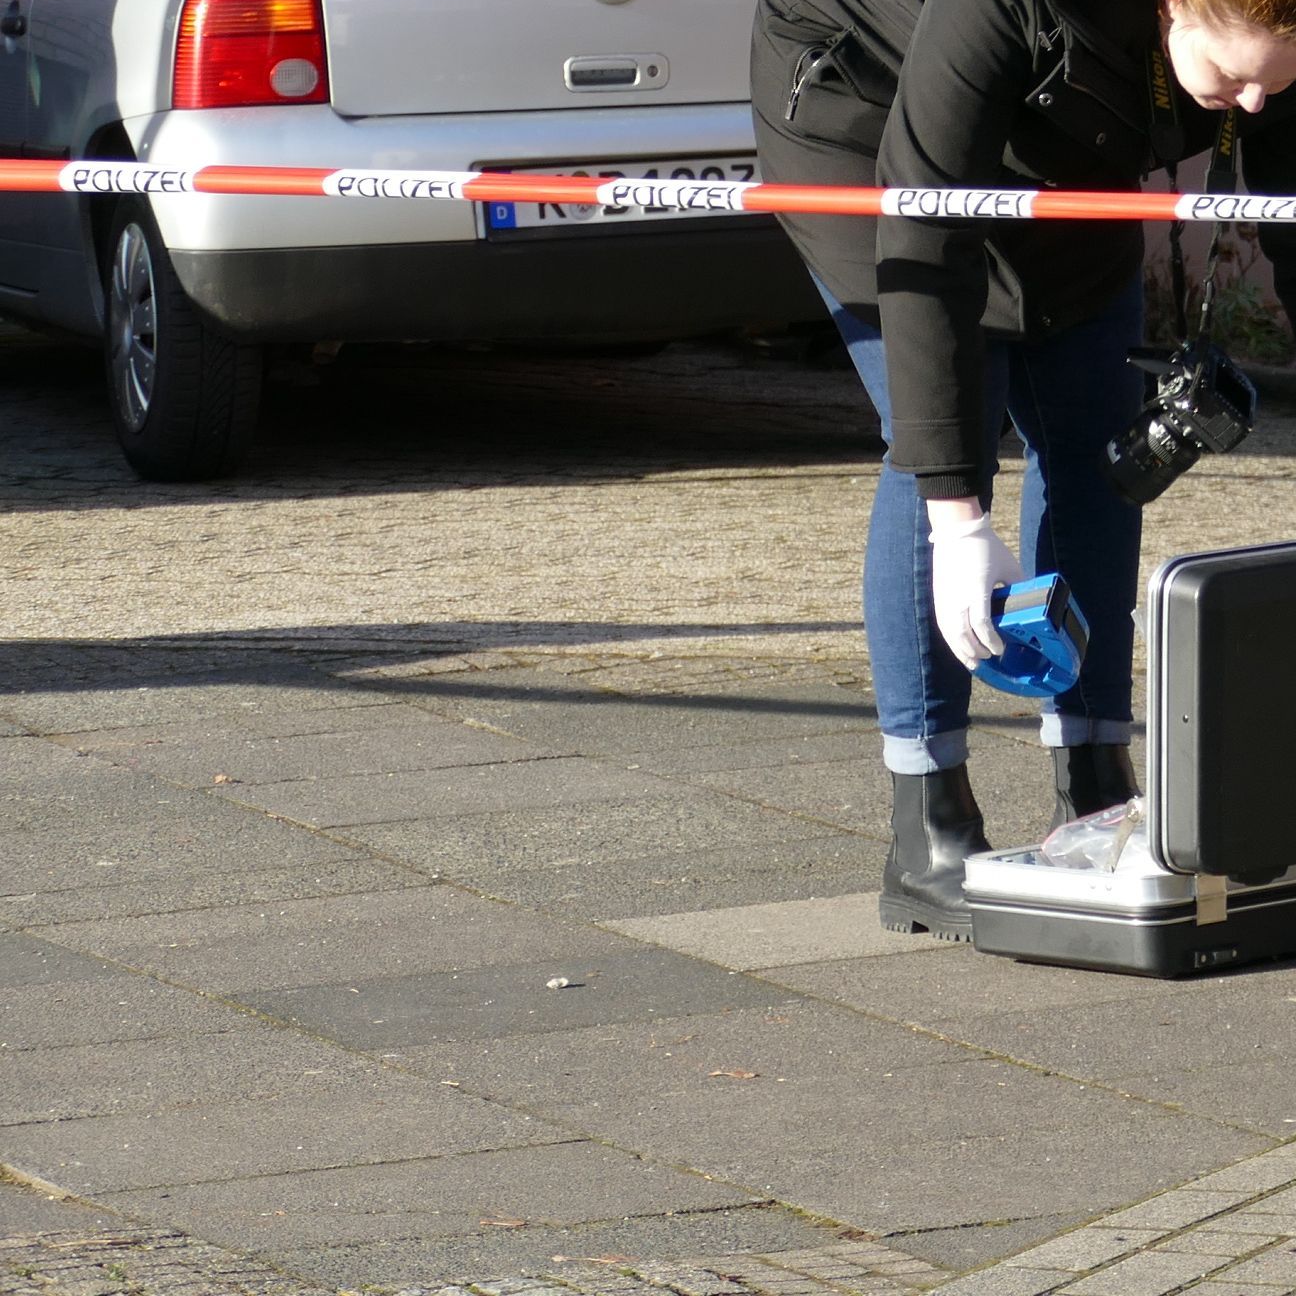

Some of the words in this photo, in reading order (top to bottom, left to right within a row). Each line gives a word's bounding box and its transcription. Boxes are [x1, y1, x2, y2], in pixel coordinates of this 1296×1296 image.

[1220, 108, 1234, 156] Niko
[73, 169, 187, 193] POLIZEI
[337, 176, 456, 199] POLIZEI
[612, 185, 737, 210] POLIZEI
[897, 190, 1026, 217] POLIZEI
[496, 205, 508, 220] D
